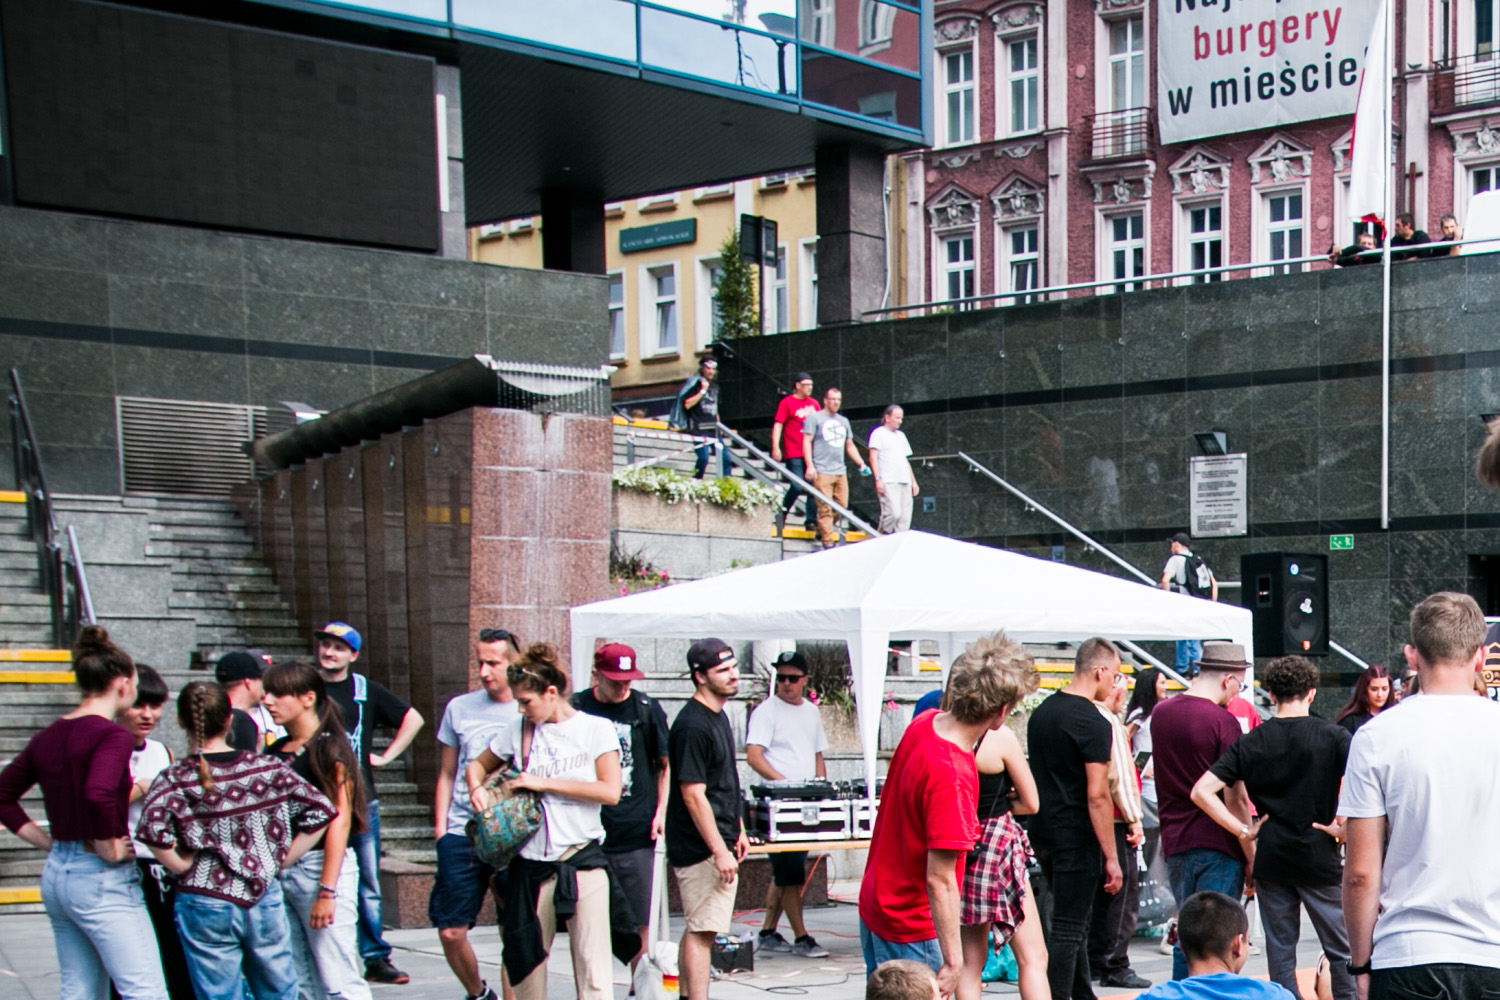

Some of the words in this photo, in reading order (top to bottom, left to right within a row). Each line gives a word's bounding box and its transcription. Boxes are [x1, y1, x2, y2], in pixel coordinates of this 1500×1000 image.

[1194, 7, 1342, 61] burgery
[1168, 86, 1193, 116] w
[1210, 46, 1368, 108] mieście
